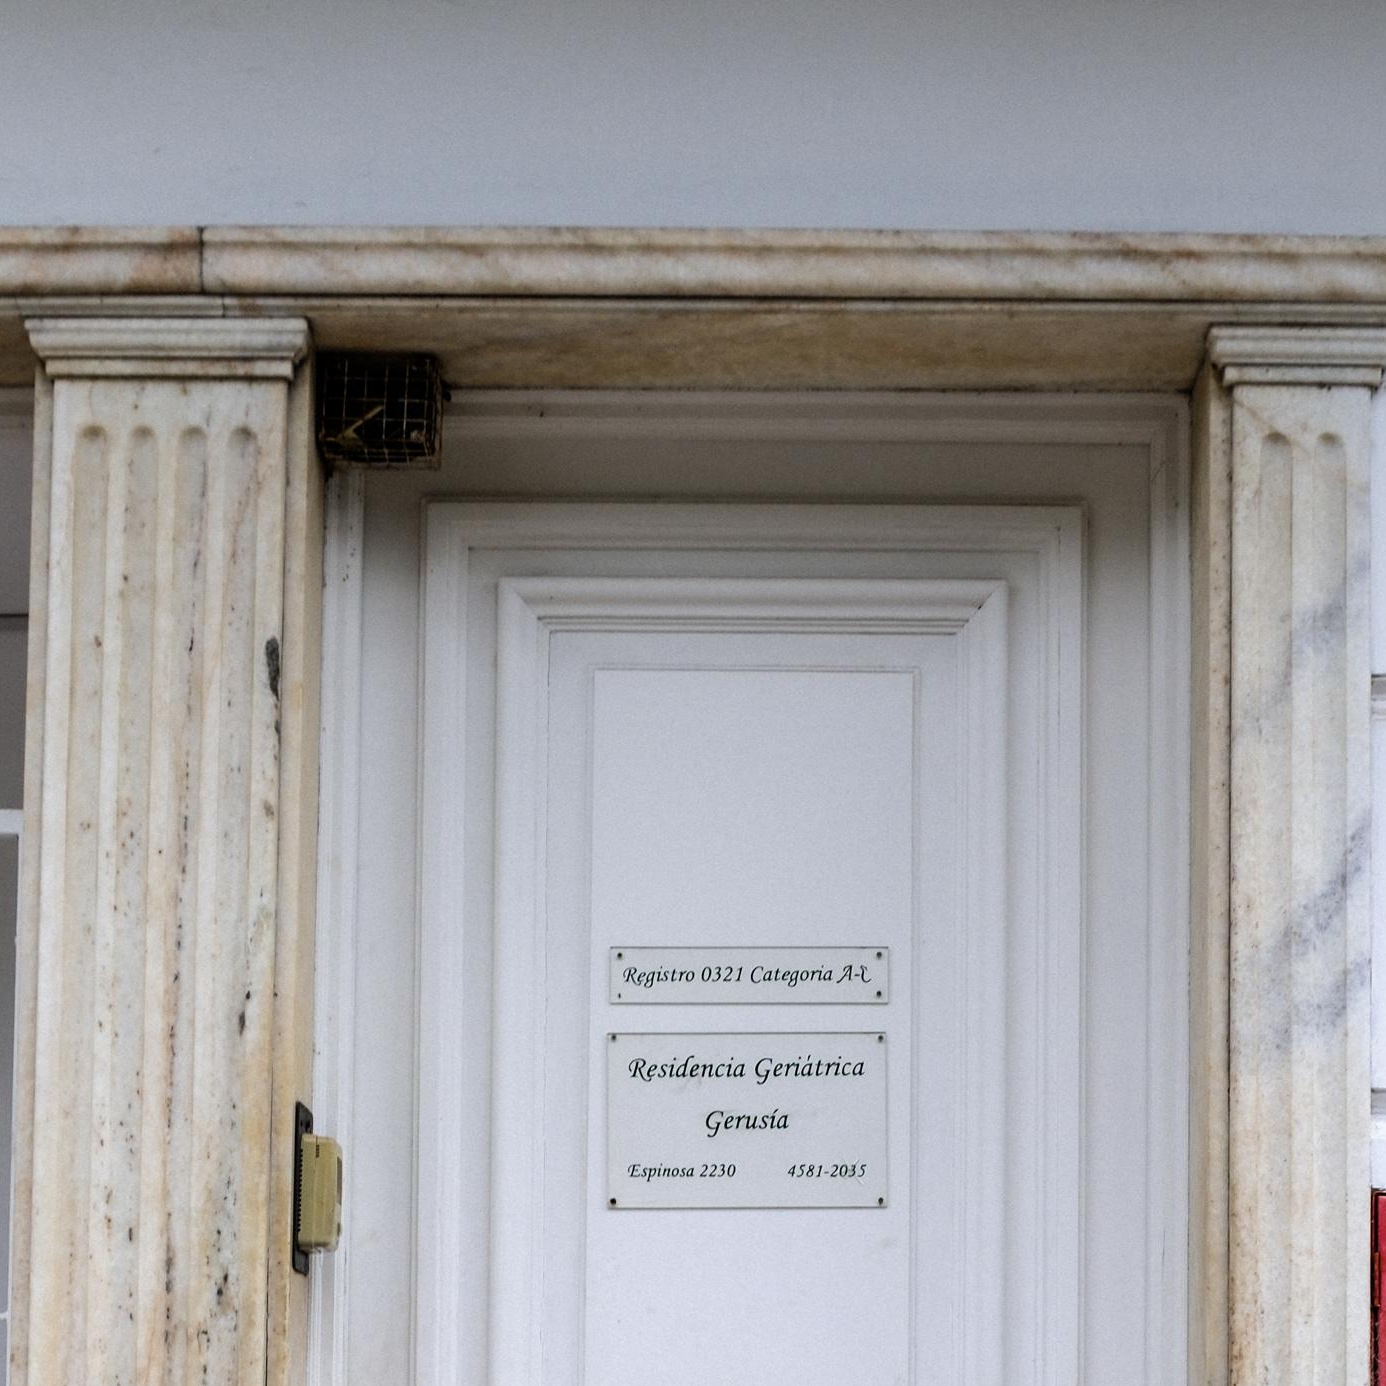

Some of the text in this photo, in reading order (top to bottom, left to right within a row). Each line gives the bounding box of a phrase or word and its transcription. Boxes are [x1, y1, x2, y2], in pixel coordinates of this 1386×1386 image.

[622, 964, 696, 989] Registro
[700, 965, 744, 983] 0321
[750, 964, 834, 988] Categoria
[627, 1053, 866, 1086] Residencia Geriátrica
[705, 1108, 790, 1138] Gerusía
[627, 1162, 737, 1183] Espinosa 2230
[787, 1162, 868, 1179] 4581-2035
